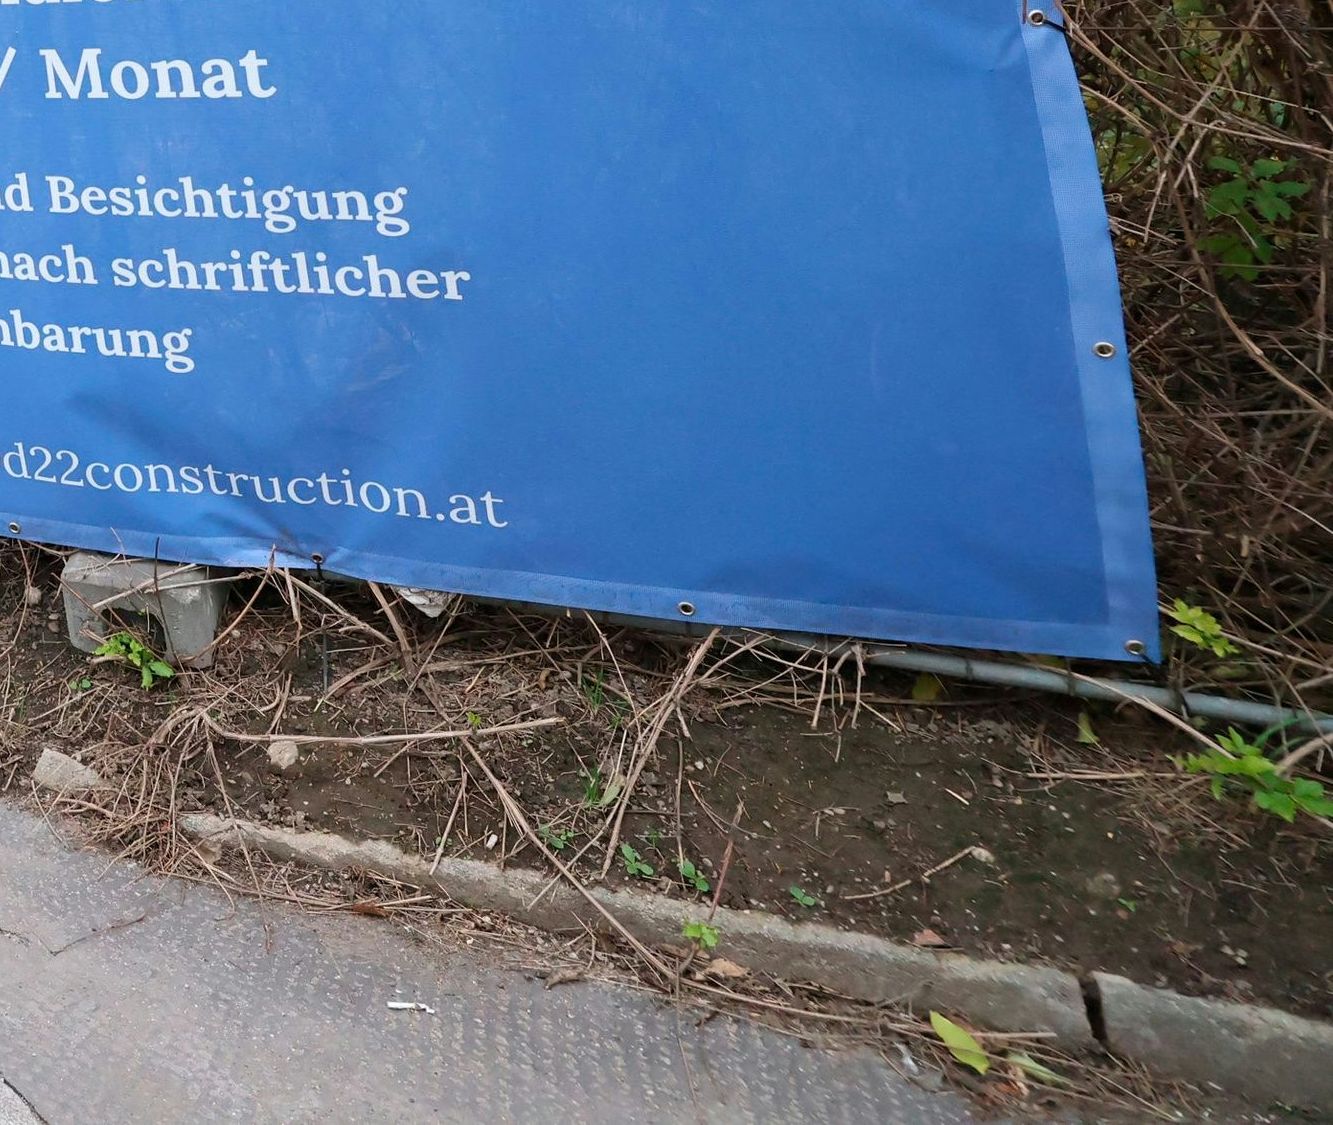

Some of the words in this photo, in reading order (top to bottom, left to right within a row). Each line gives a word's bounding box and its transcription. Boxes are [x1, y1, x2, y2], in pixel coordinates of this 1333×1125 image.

[39, 48, 277, 99] Monat
[45, 175, 410, 236] Besichtigung
[112, 248, 470, 300] schriftlicher
